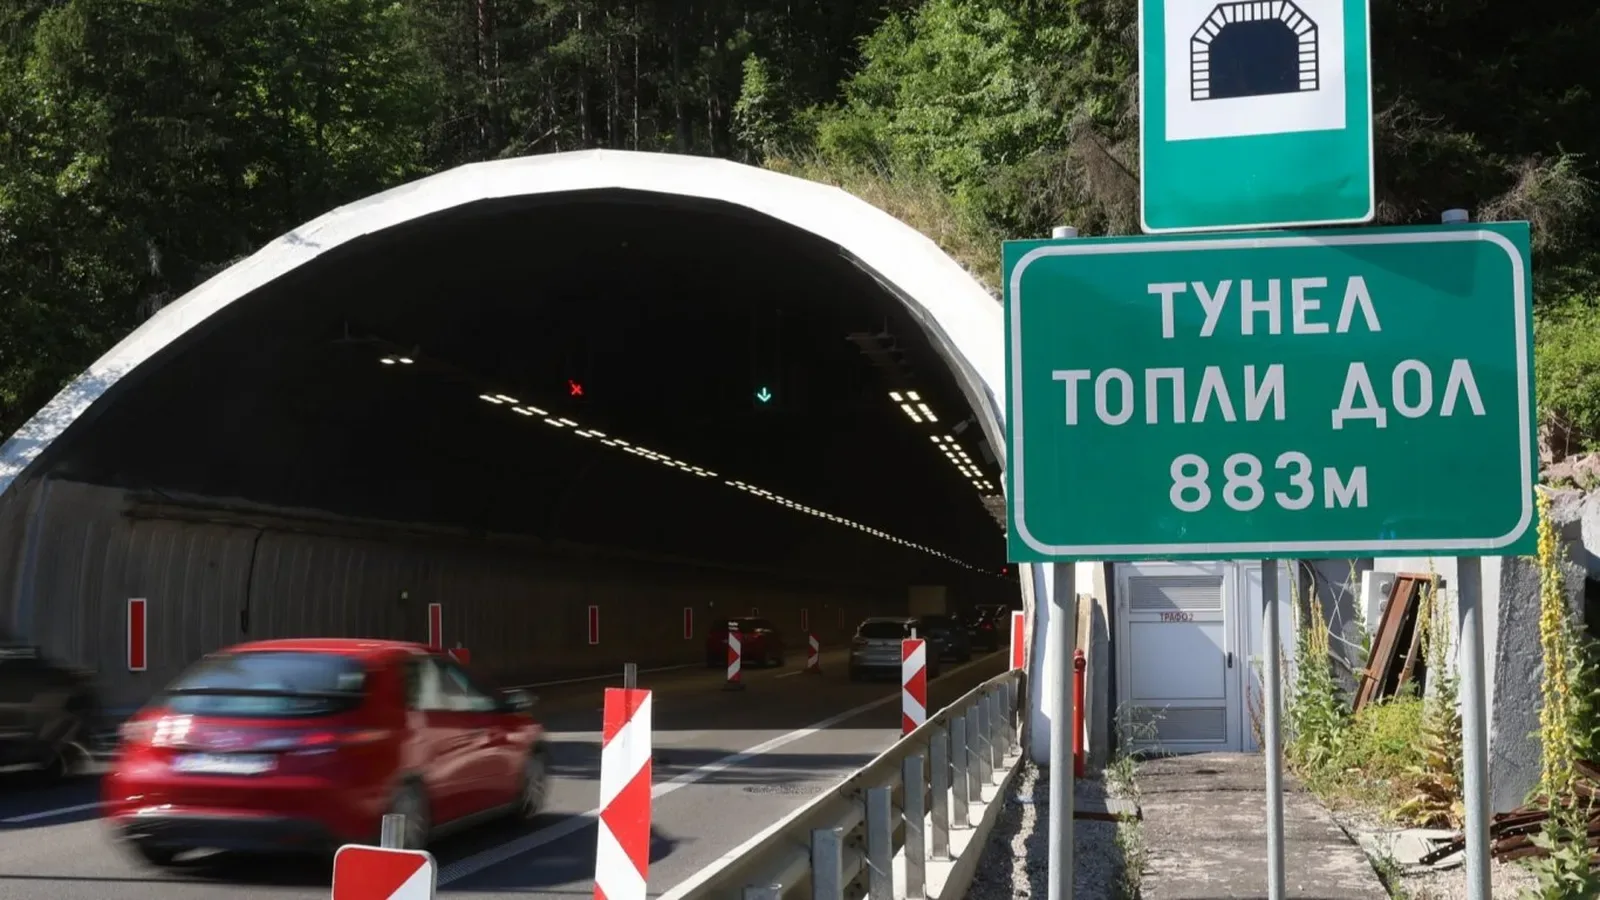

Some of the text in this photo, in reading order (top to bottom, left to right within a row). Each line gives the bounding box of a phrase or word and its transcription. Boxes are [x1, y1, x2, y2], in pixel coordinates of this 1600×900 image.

[1148, 276, 1381, 338] ТУНЕЛ
[1052, 359, 1486, 430] ТОПЛИ ДОЛ
